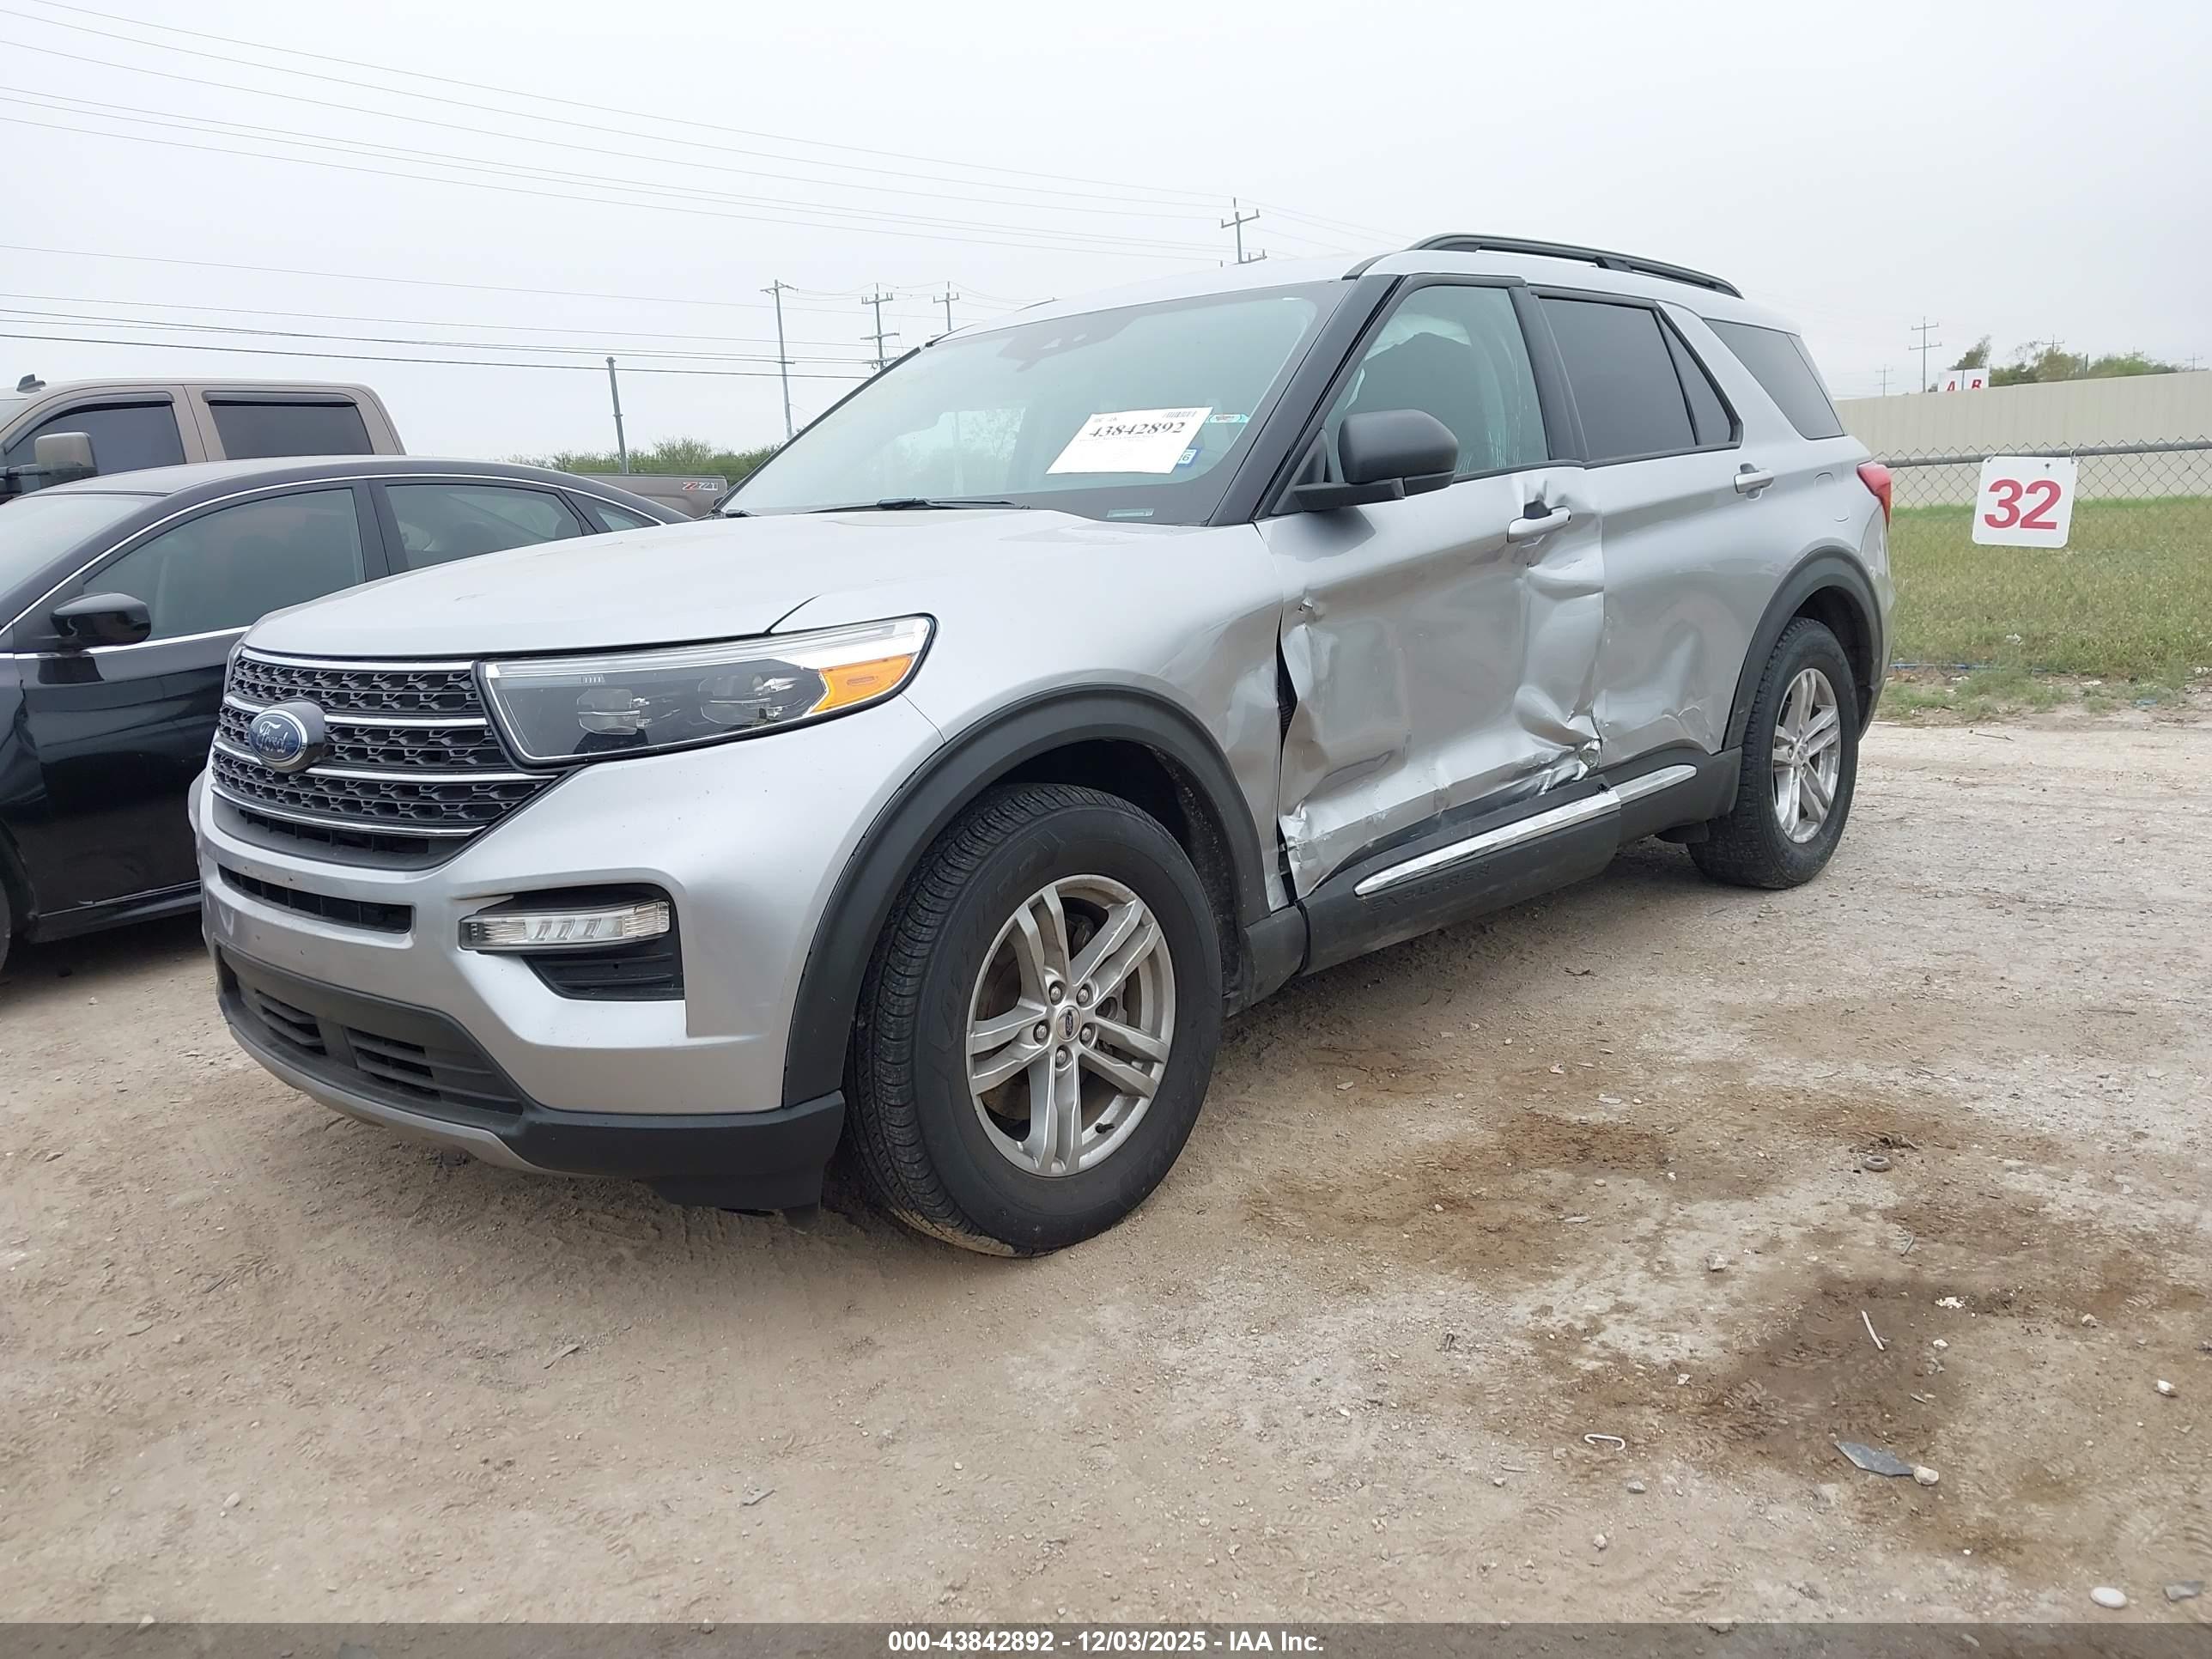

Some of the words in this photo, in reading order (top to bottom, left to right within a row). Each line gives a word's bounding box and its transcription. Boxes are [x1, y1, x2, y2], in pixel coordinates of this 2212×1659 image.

[1088, 422, 1186, 437] 43842892
[1984, 478, 2062, 530] 32
[259, 720, 289, 754] Ford
